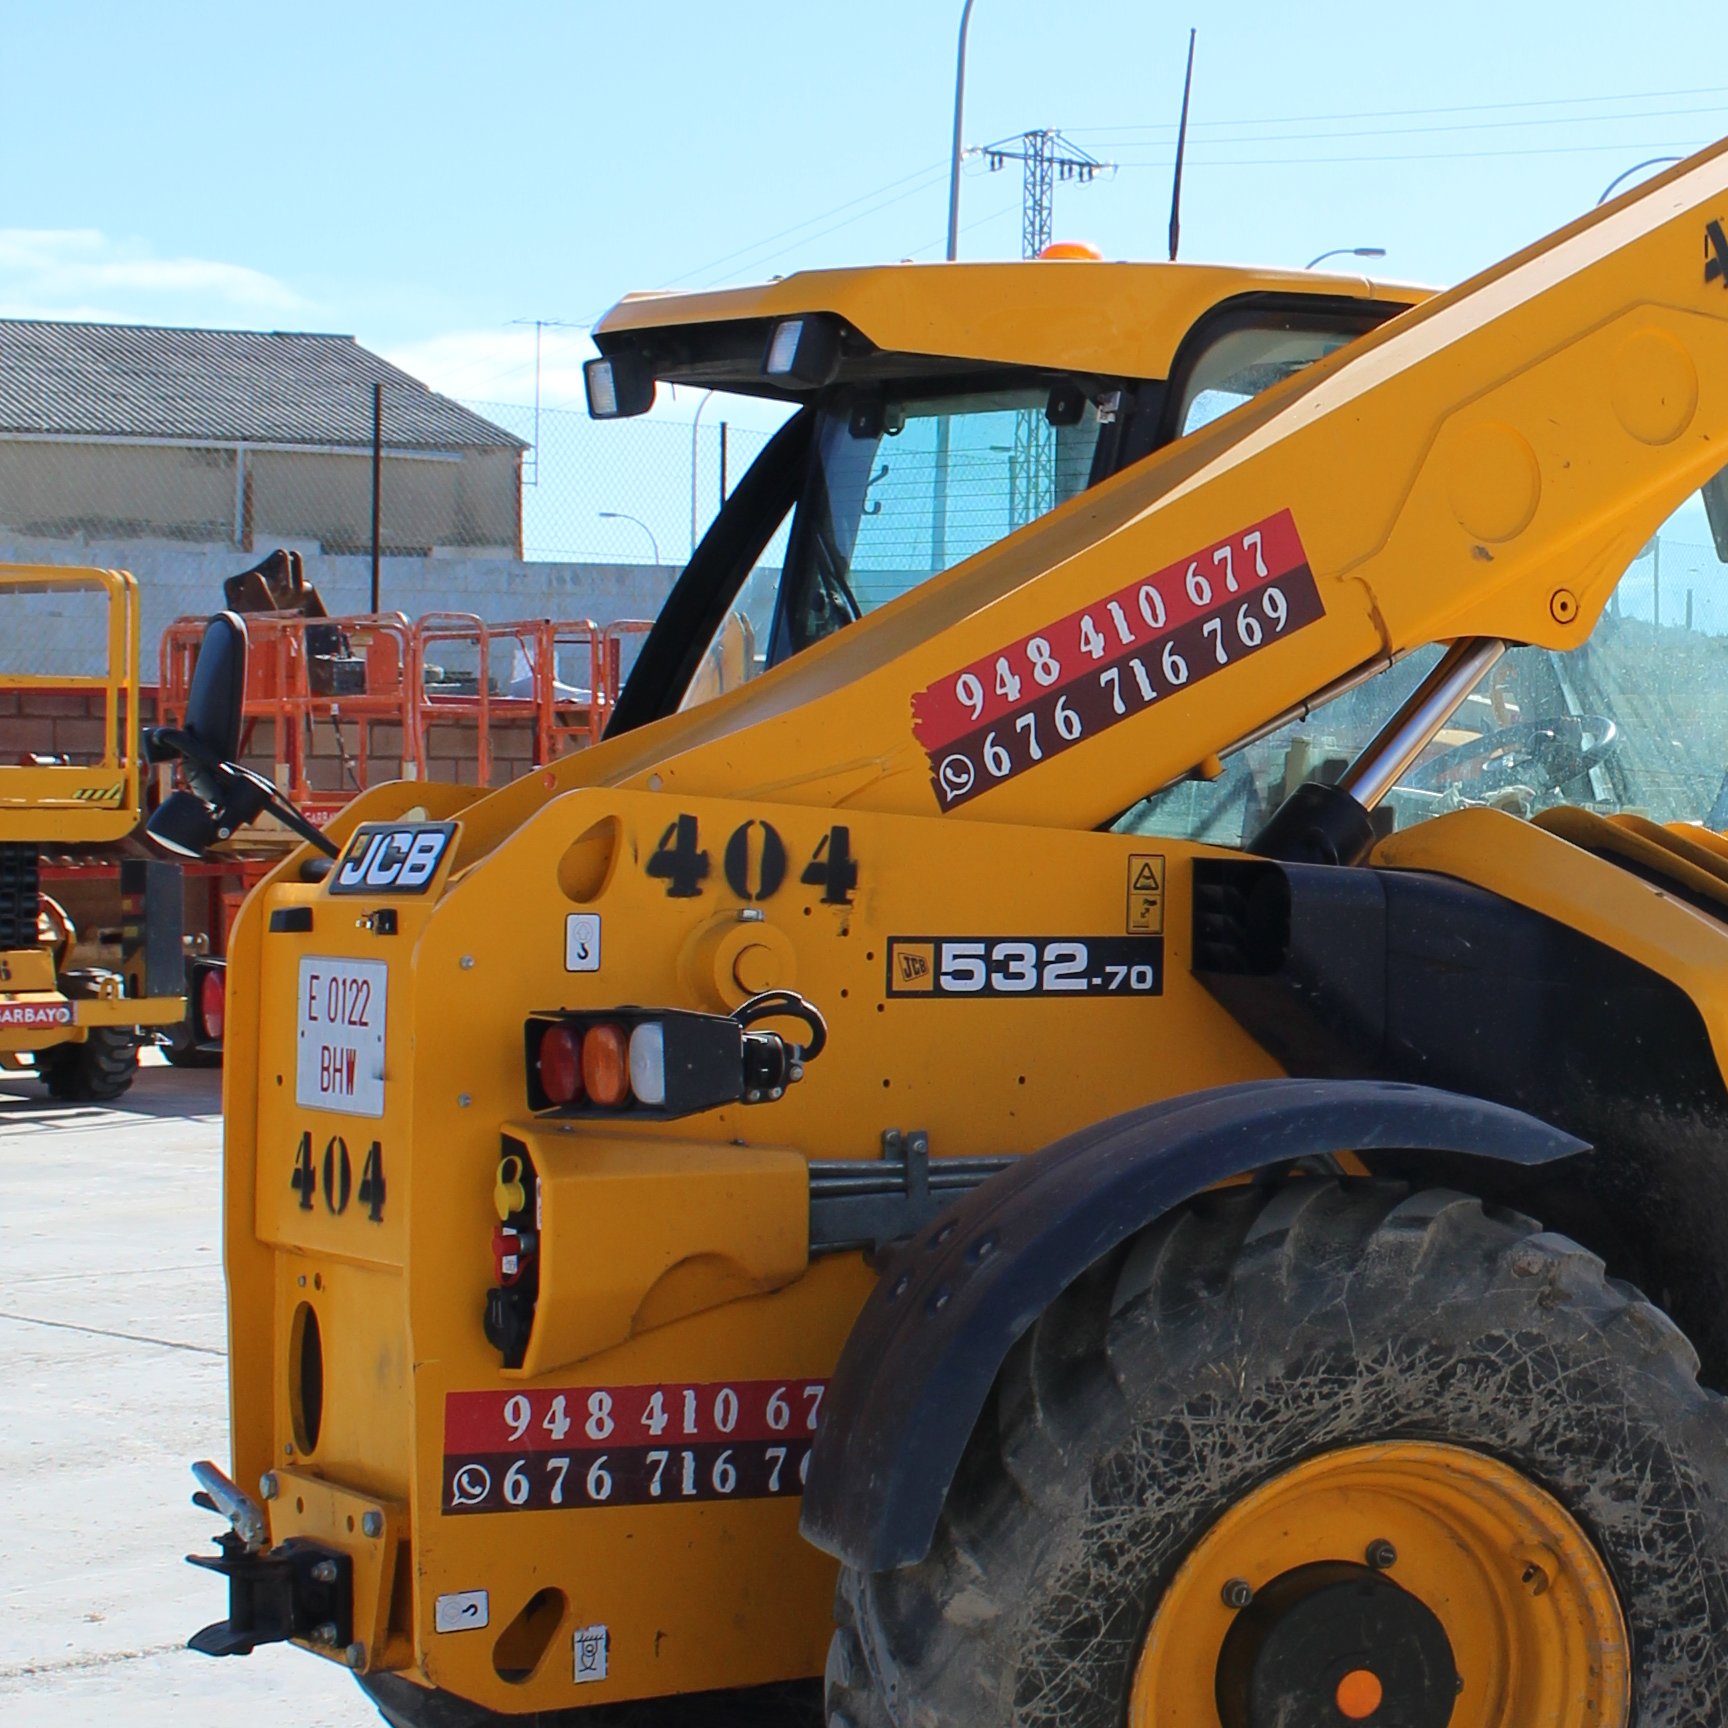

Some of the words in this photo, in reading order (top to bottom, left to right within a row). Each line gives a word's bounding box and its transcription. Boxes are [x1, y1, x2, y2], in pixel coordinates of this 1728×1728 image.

[955, 636, 1060, 720] 948
[1078, 584, 1167, 661] 410
[1185, 530, 1269, 606] 677
[983, 695, 1083, 776] 676
[1100, 648, 1189, 716] 716
[1202, 588, 1288, 665] 769
[340, 833, 446, 885] JCB
[647, 813, 858, 906] 404
[903, 958, 927, 976] JCB
[0, 1007, 71, 1023] ARBAYO
[308, 974, 320, 1021] E
[327, 976, 370, 1027] 0122
[320, 1045, 356, 1095] BHW
[290, 1129, 386, 1223] 404
[504, 1390, 614, 1442] 948
[640, 1387, 739, 1435] 410
[503, 1455, 612, 1505] 676
[646, 1449, 736, 1497] 716
[765, 1447, 813, 1492] 7
